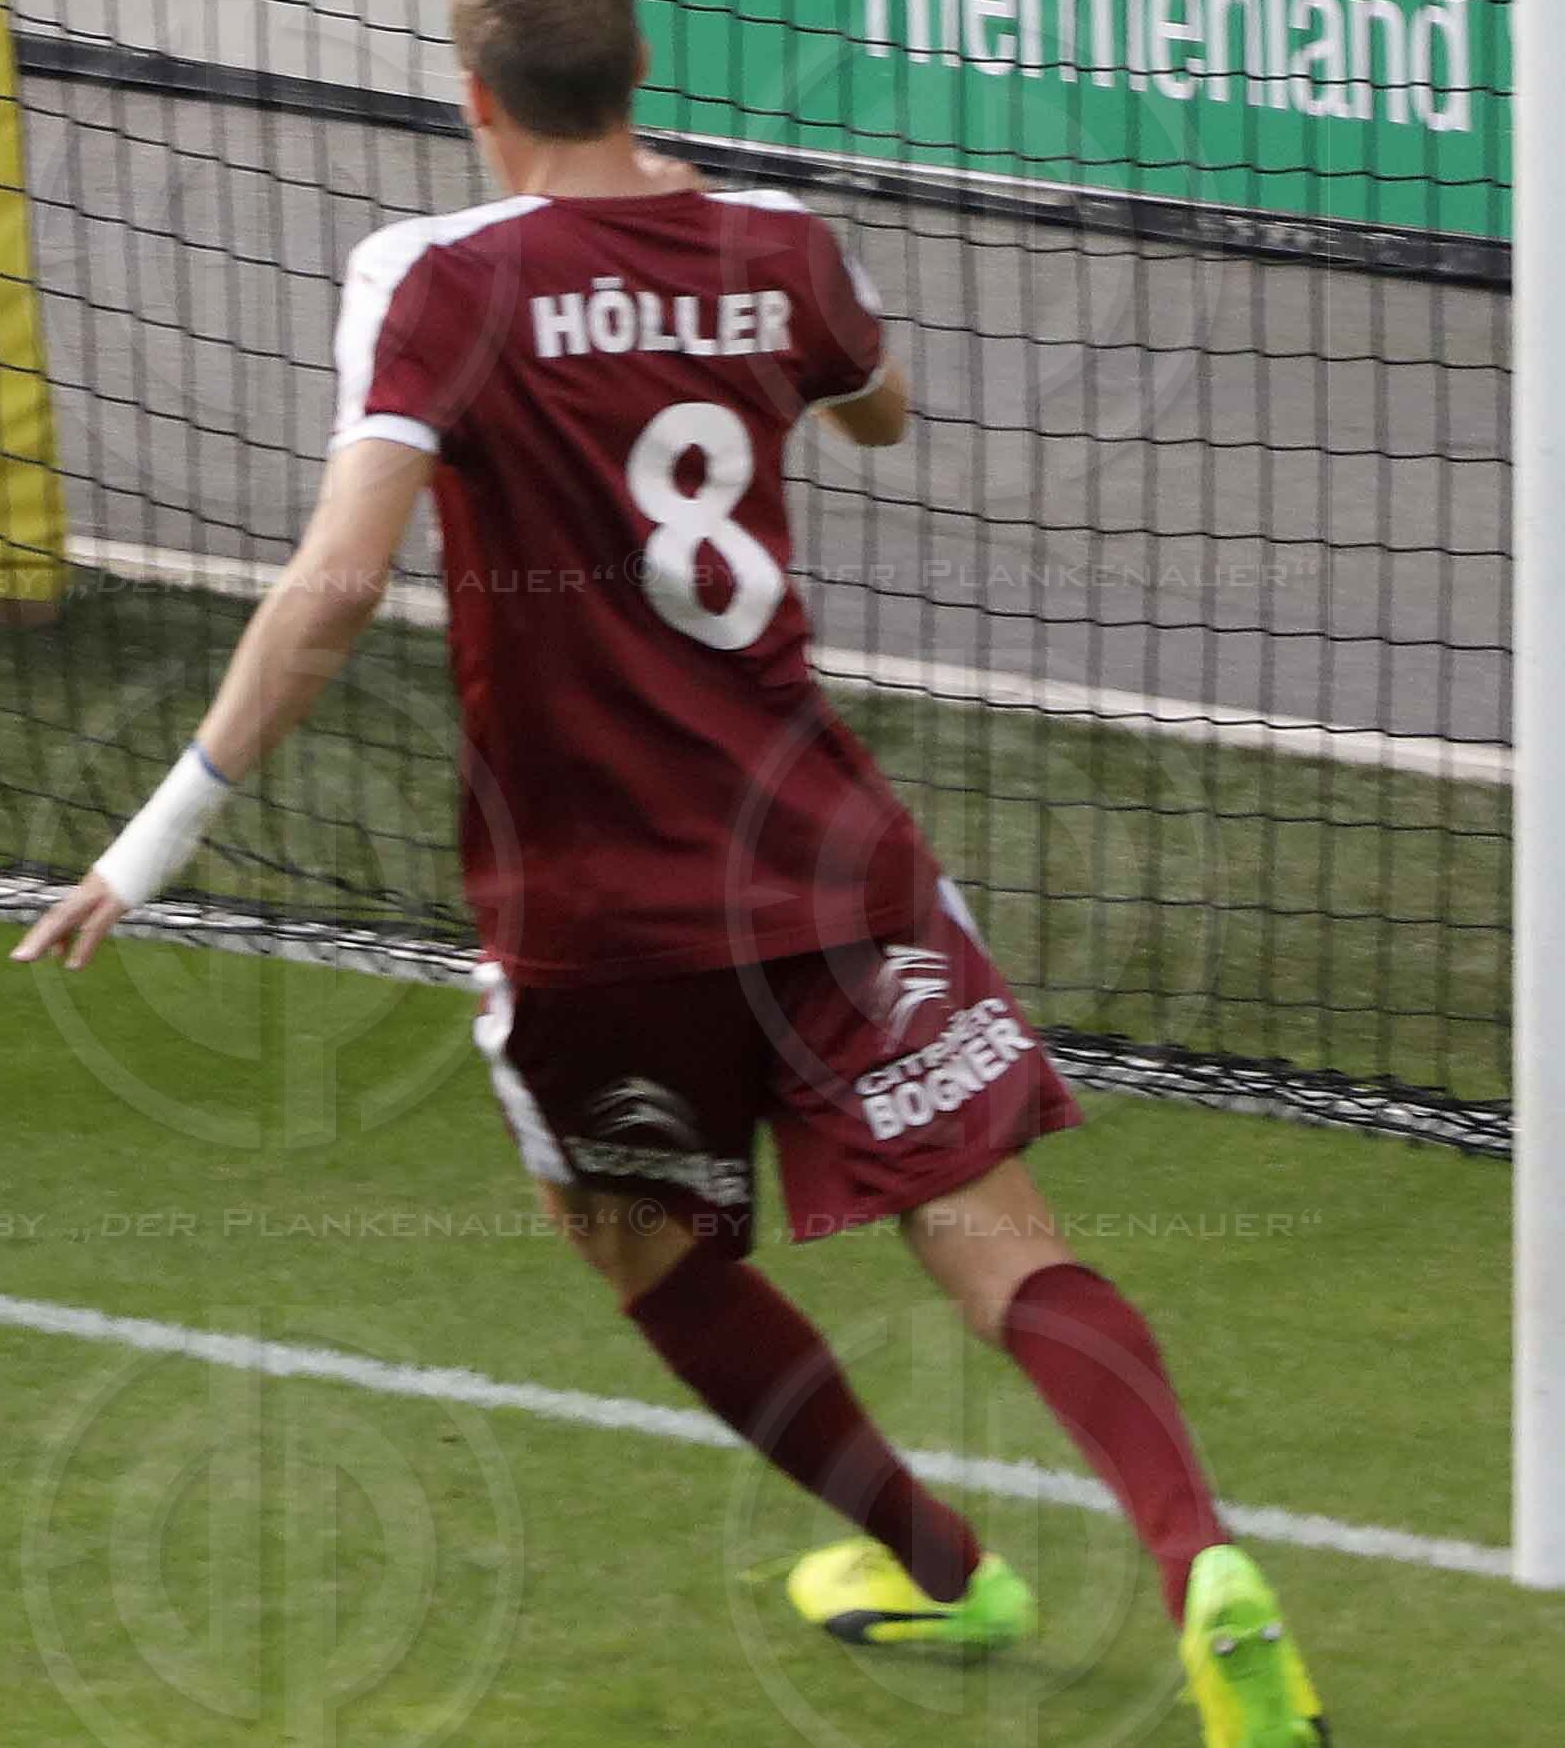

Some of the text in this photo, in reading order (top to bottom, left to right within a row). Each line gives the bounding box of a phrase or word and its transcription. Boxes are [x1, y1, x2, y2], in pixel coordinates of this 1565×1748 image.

[529, 277, 792, 359] HÖLLER
[625, 401, 785, 651] 8
[863, 1016, 1036, 1142] BOGNER
